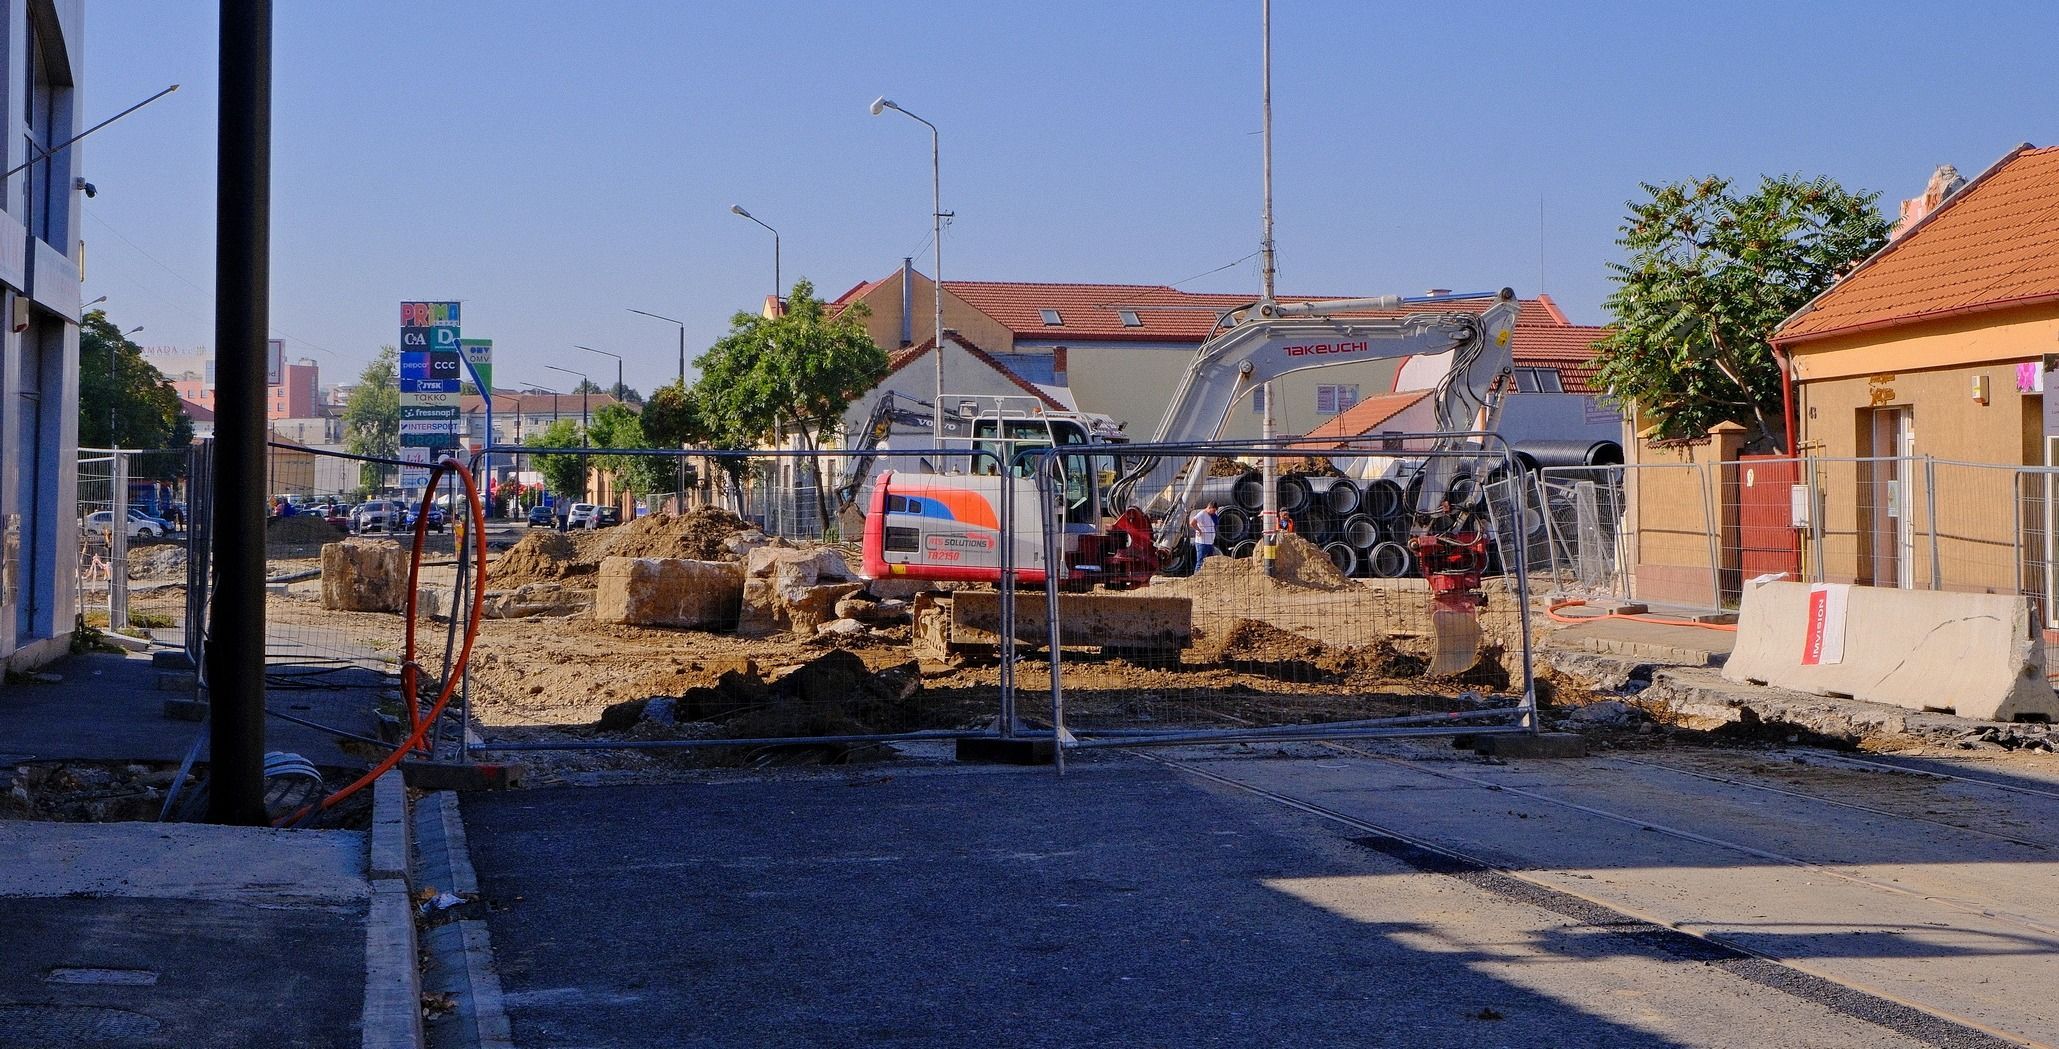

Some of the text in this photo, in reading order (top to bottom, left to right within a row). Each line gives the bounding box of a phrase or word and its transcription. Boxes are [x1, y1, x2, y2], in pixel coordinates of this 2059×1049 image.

[404, 333, 427, 345] C&A
[437, 329, 454, 345] D
[142, 345, 178, 354] AMADA
[1283, 341, 1367, 356] TAKEUCHI
[434, 361, 456, 370] CCC
[415, 408, 455, 417] fressnapf
[916, 417, 957, 431] VOO
[944, 538, 987, 548] SOLUTIONS
[927, 551, 960, 561] TB2150
[1812, 599, 1824, 658] IMVISION
